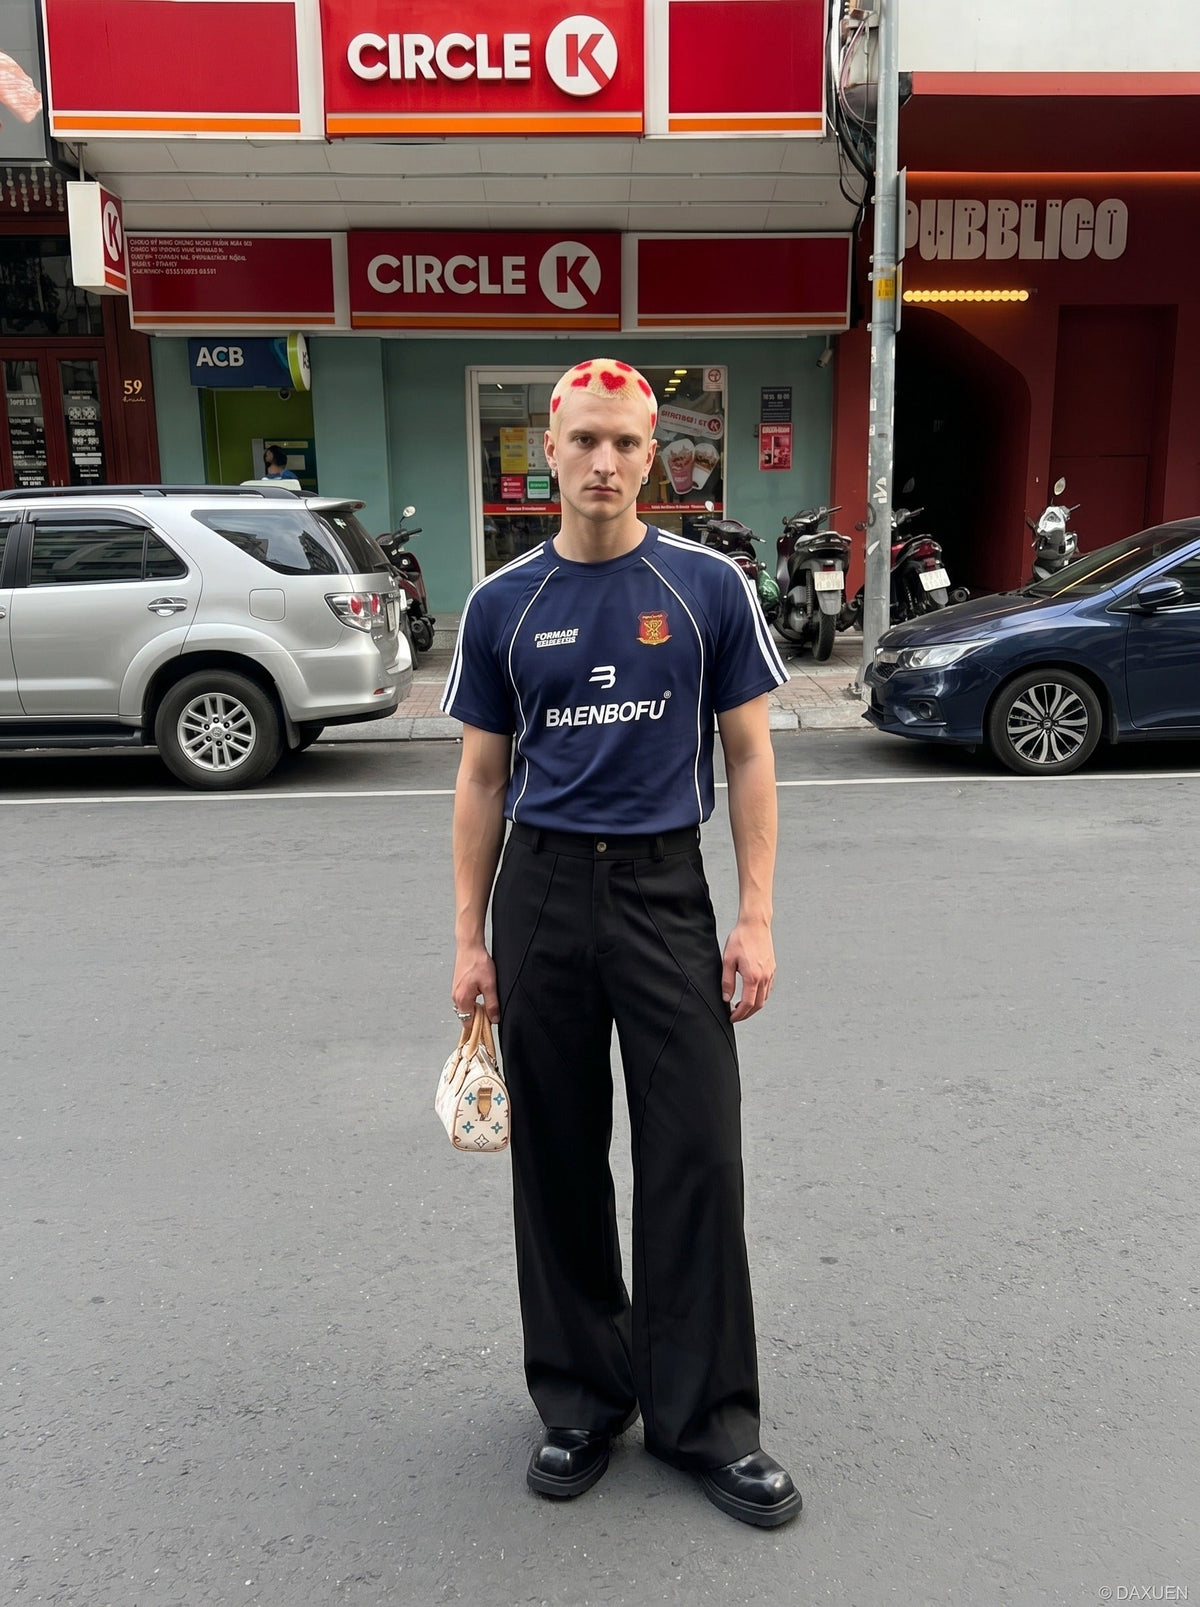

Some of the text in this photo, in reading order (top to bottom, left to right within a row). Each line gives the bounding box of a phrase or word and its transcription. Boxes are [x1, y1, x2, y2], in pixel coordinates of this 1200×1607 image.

[347, 32, 612, 88] CIRCLE K
[367, 254, 596, 304] CIRCLE K
[196, 346, 245, 367] ACB
[123, 379, 143, 395] 59
[534, 628, 579, 641] FORMADE
